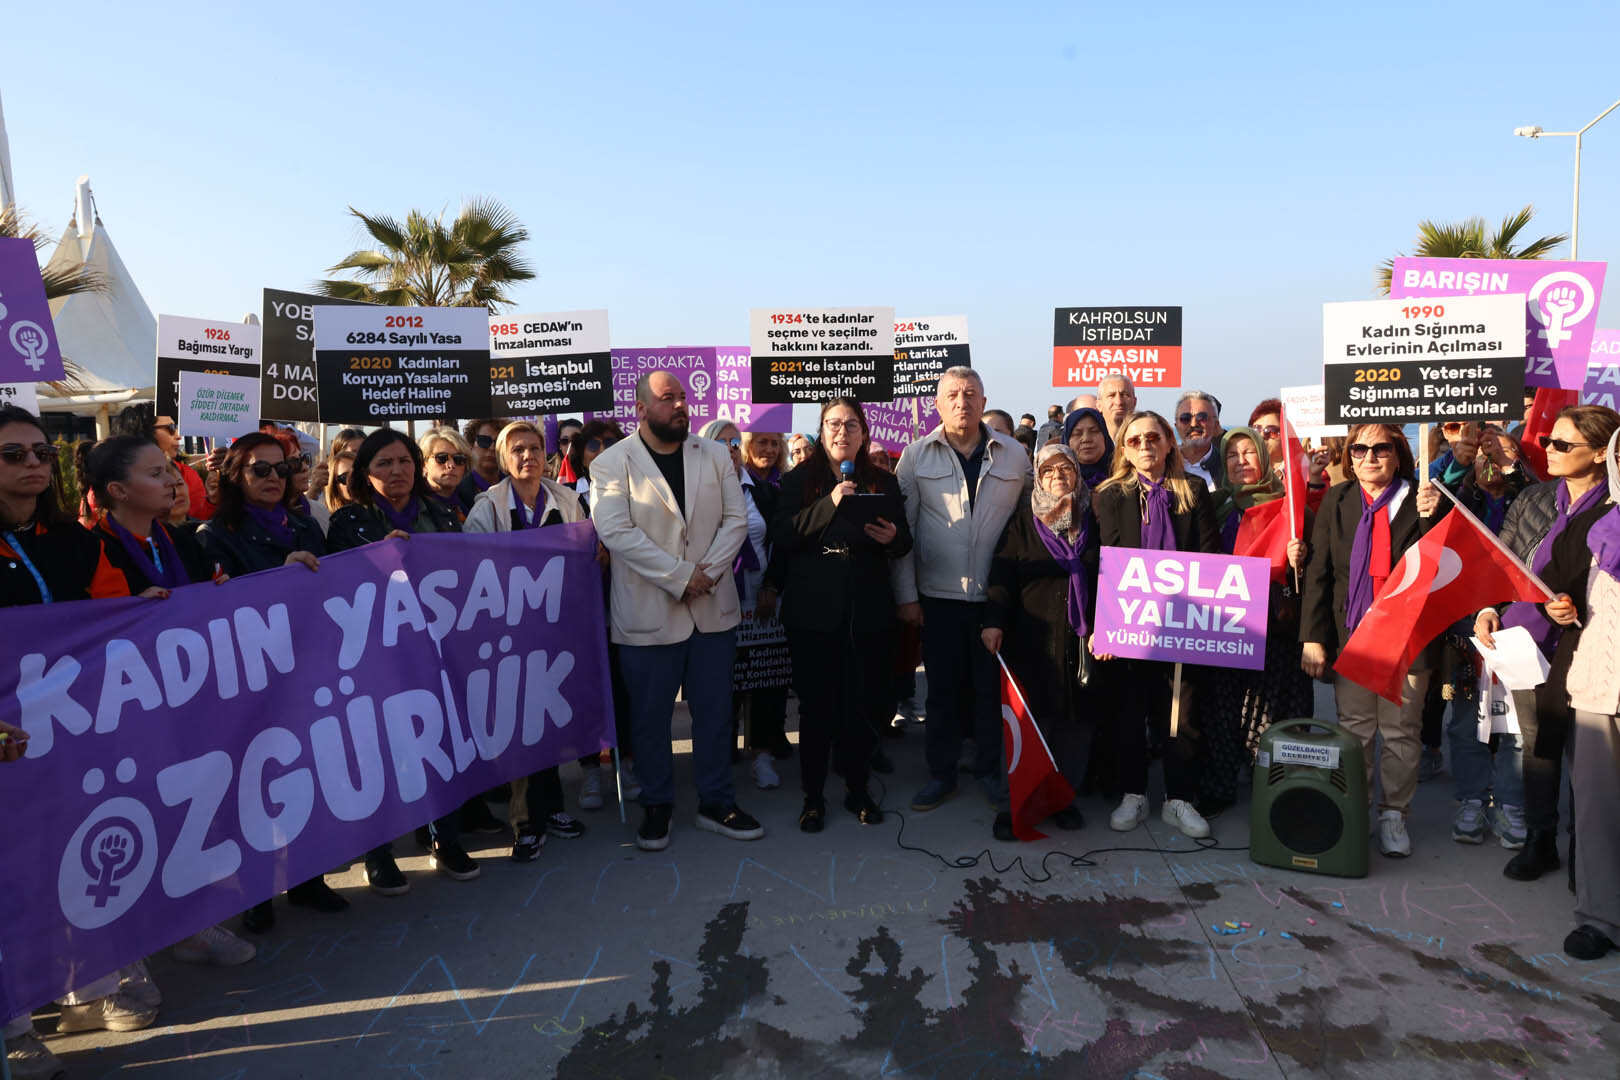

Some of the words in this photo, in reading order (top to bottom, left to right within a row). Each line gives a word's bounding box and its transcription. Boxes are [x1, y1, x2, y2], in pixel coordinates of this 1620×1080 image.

[1403, 269, 1509, 295] BARIŞIN
[822, 313, 874, 324] kadınlar
[1069, 311, 1167, 324] KAHROLSUN
[1401, 305, 1445, 319] 1990
[385, 315, 424, 328] 2012
[204, 328, 230, 340] 1926
[767, 329, 809, 340] seçme
[811, 329, 826, 337] ve
[828, 326, 878, 339] seçilme
[1082, 326, 1154, 341] İSTİBDAT
[1362, 325, 1410, 338] Kadın
[1414, 322, 1486, 338] Sığınma
[346, 332, 387, 344] 6284
[388, 332, 428, 347] Sayılı
[429, 332, 462, 344] Yasa
[771, 341, 818, 351] hakkını
[821, 341, 873, 351] kazandı.
[178, 339, 228, 355] Bağımsız
[228, 344, 253, 359] Yargı
[909, 348, 948, 359] tarikat
[1346, 341, 1423, 356] Evlerinin
[1427, 340, 1502, 356] Açılması
[350, 357, 392, 369] 2020
[398, 357, 460, 369] Kadınları
[637, 355, 705, 369] SOKAKTA
[1074, 348, 1159, 366] YAŞASIN
[267, 363, 279, 379] 4
[525, 359, 593, 377] İstanbul
[823, 359, 875, 371] İstanbul
[342, 373, 403, 387] Koruyan
[405, 372, 468, 384] Yasaların
[1354, 368, 1401, 382] 2020
[1418, 365, 1492, 380] Yetersiz
[362, 387, 405, 400] Hedef
[408, 387, 452, 399] Haline
[1349, 386, 1420, 402] Sığınma
[1423, 383, 1474, 398] Evleri
[1478, 384, 1498, 396] ve
[369, 401, 447, 415] Getirilmesi
[506, 397, 571, 411] vazgeçme
[1339, 404, 1431, 418] Korumasız
[1434, 401, 1508, 415] Kadınlar
[1117, 556, 1251, 601] ASLA
[1117, 597, 1247, 634] YALNIZ
[1106, 629, 1254, 656] YÜRÜMEYECEKSİN
[16, 602, 295, 759] KADIN
[323, 556, 565, 670] YAŞAM
[57, 635, 575, 930] ÖZGÜRLÜK
